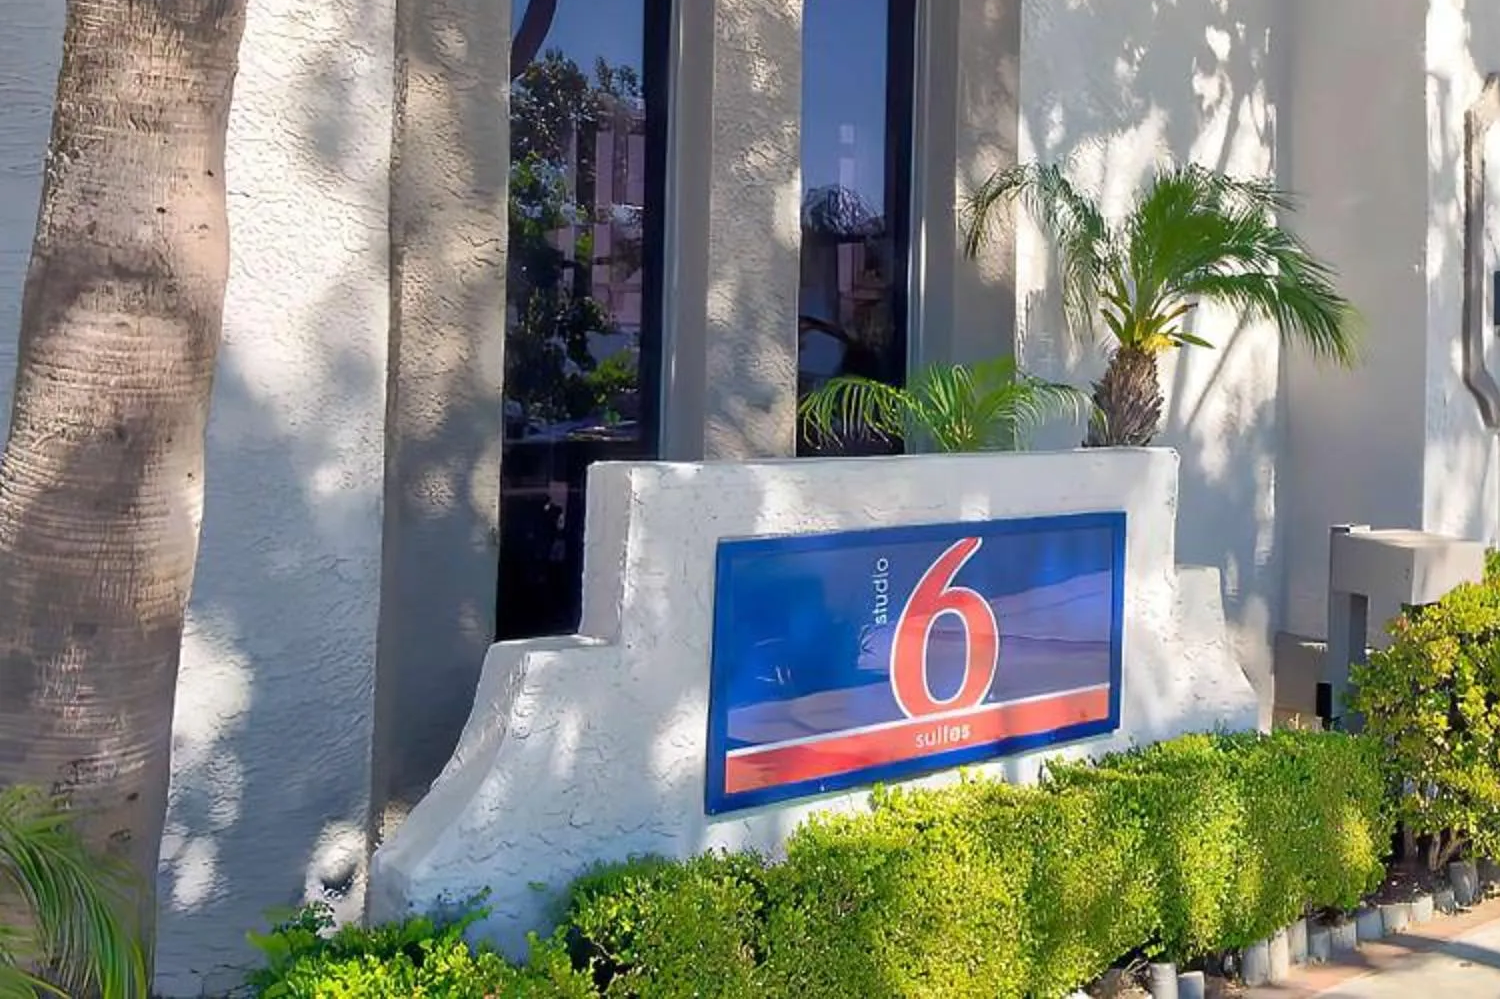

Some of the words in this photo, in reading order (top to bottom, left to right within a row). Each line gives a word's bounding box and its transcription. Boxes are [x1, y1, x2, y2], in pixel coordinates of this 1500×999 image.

[872, 558, 889, 625] studio
[890, 536, 1000, 719] 6
[915, 724, 972, 749] suites
